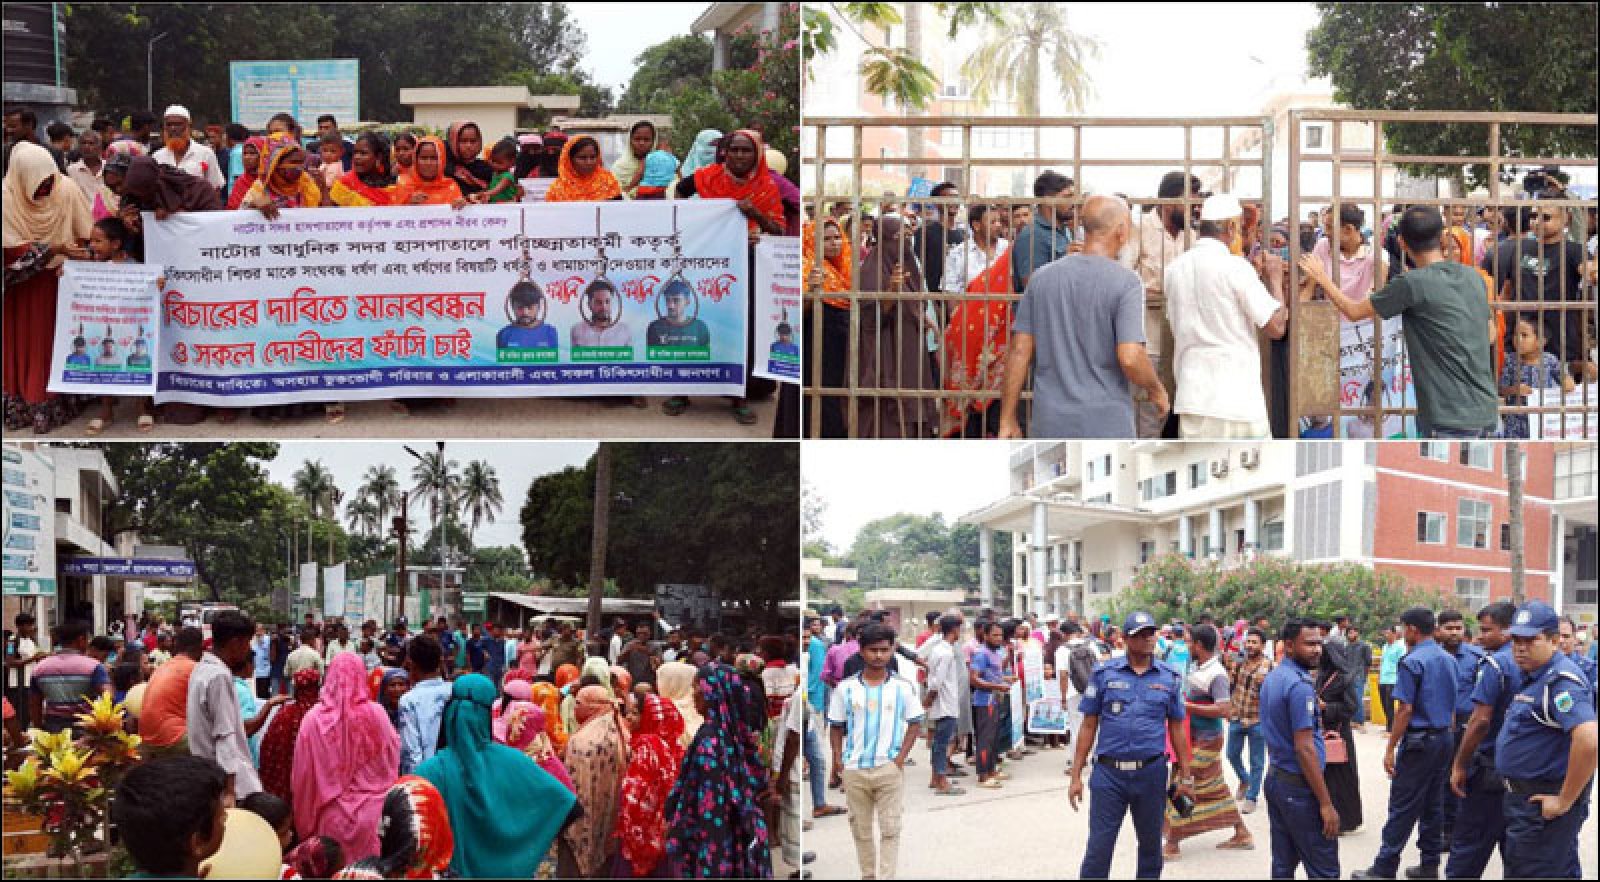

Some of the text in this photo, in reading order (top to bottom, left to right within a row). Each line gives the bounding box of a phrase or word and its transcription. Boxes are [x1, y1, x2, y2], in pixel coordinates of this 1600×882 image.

[200, 243, 261, 260] নাটোর
[268, 239, 340, 259] আধুনিক
[347, 240, 387, 254] সদর
[393, 238, 491, 254] হাসপাতালে
[163, 290, 260, 329] বিচারের
[265, 286, 350, 325] দাবিতে
[355, 290, 487, 322] মানববন্ধন
[172, 325, 473, 368] ও সকল দোষীদের ফাঁসি চাই
